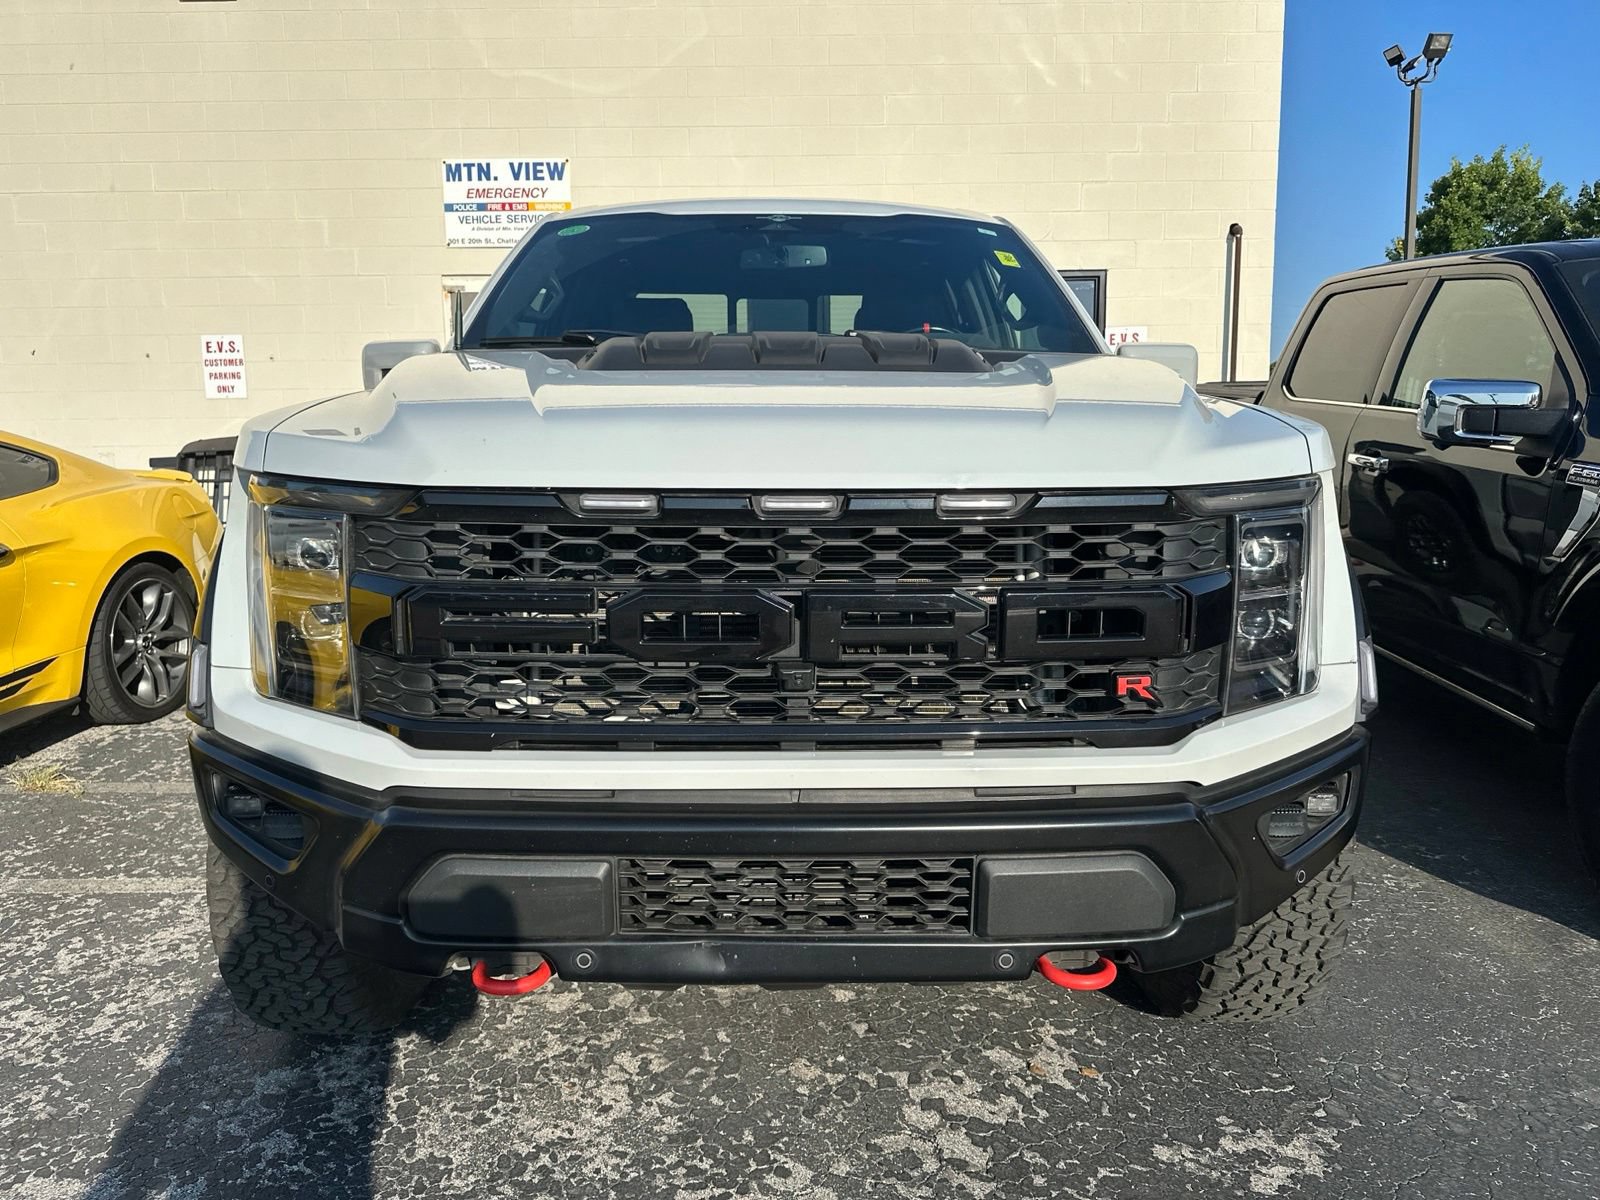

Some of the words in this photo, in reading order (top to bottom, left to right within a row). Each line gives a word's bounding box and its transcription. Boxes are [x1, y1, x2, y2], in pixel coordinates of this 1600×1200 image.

[445, 162, 498, 182] MTN.
[509, 161, 566, 181] VIEW
[466, 187, 549, 199] EMERGENCY
[452, 203, 478, 211] POLICE
[487, 203, 502, 211] FIRE
[504, 203, 511, 211] &
[512, 203, 528, 211] EMS
[458, 214, 502, 225] VEHICLE
[506, 214, 544, 224] SERVIC
[205, 340, 240, 353] E.V.S.
[204, 358, 244, 367] CUSTOMER
[208, 371, 242, 380] PARKING
[217, 385, 235, 394] ONLY
[403, 585, 1187, 663] FORD
[1115, 673, 1157, 704] R
